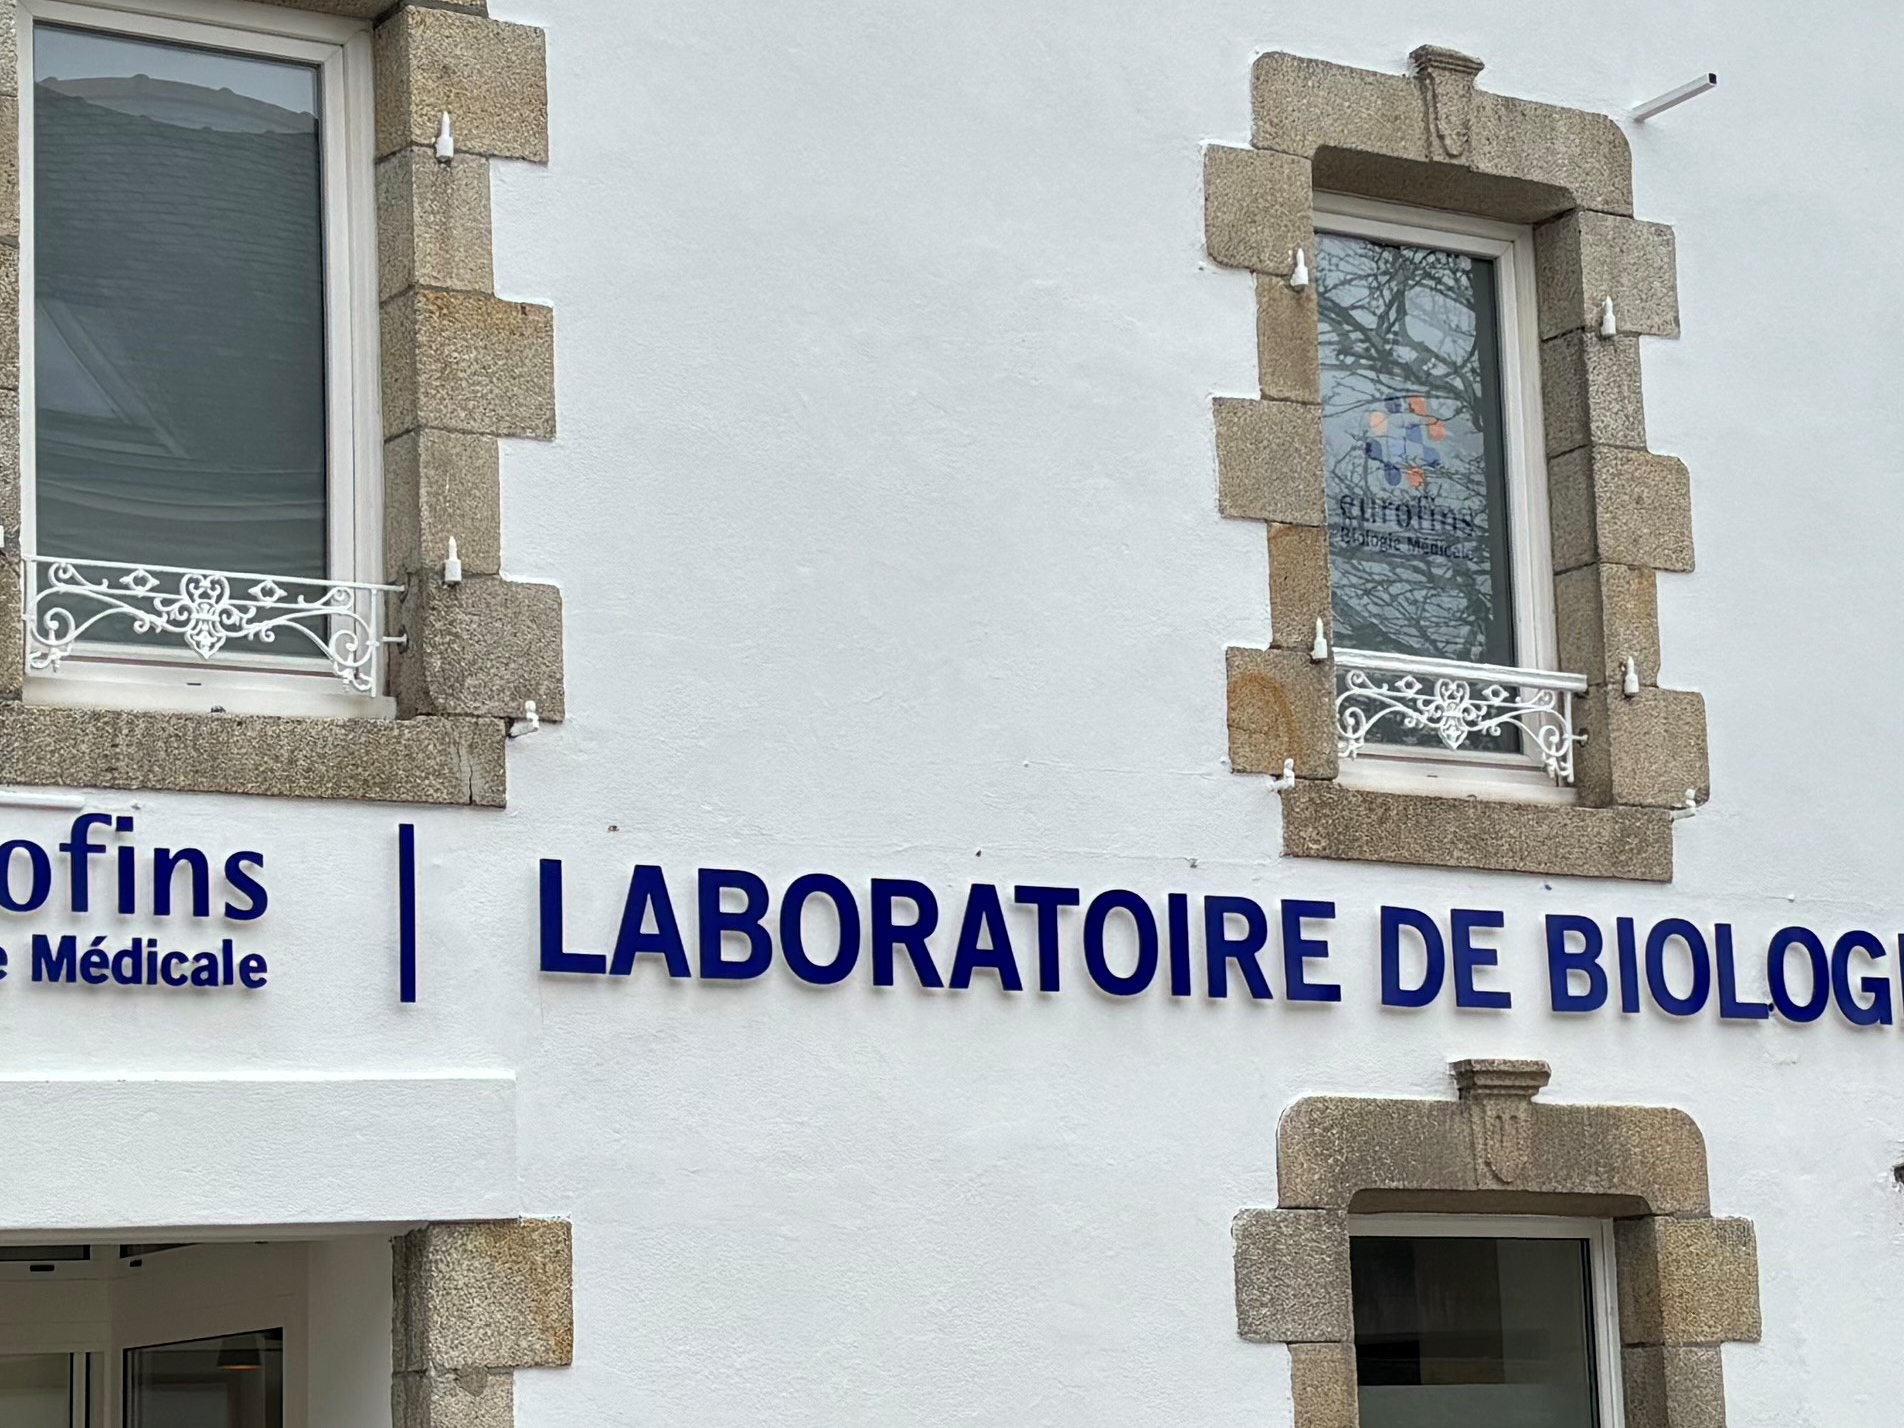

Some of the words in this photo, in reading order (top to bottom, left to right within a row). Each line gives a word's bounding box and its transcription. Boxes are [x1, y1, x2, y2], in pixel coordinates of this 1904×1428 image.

[31, 932, 269, 990] Médicale
[538, 858, 1343, 1003] LABORATOIRE
[1380, 905, 1512, 1010] DE
